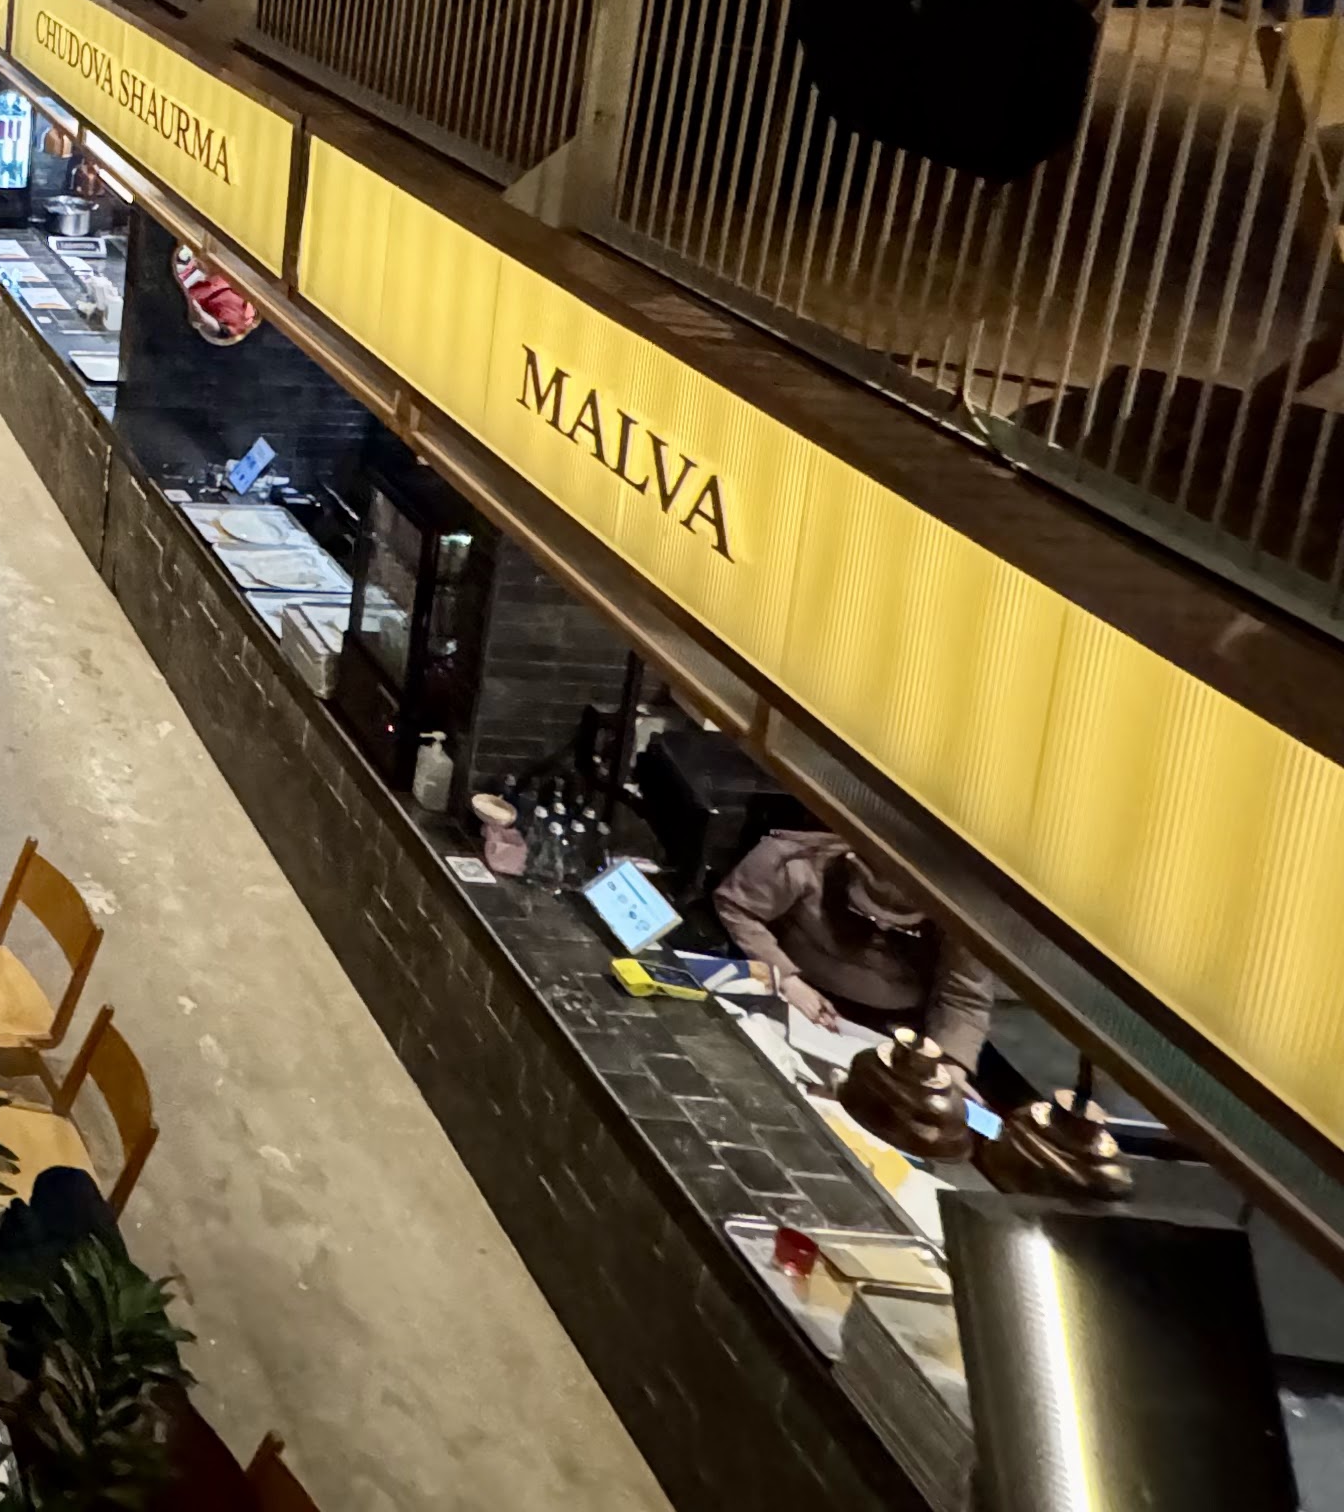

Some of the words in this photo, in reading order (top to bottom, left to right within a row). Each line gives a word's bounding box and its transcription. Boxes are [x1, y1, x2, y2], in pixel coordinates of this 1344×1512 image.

[35, 10, 115, 98] CHUDOVA
[117, 68, 231, 185] SHAURMA
[516, 343, 736, 564] MALVA
